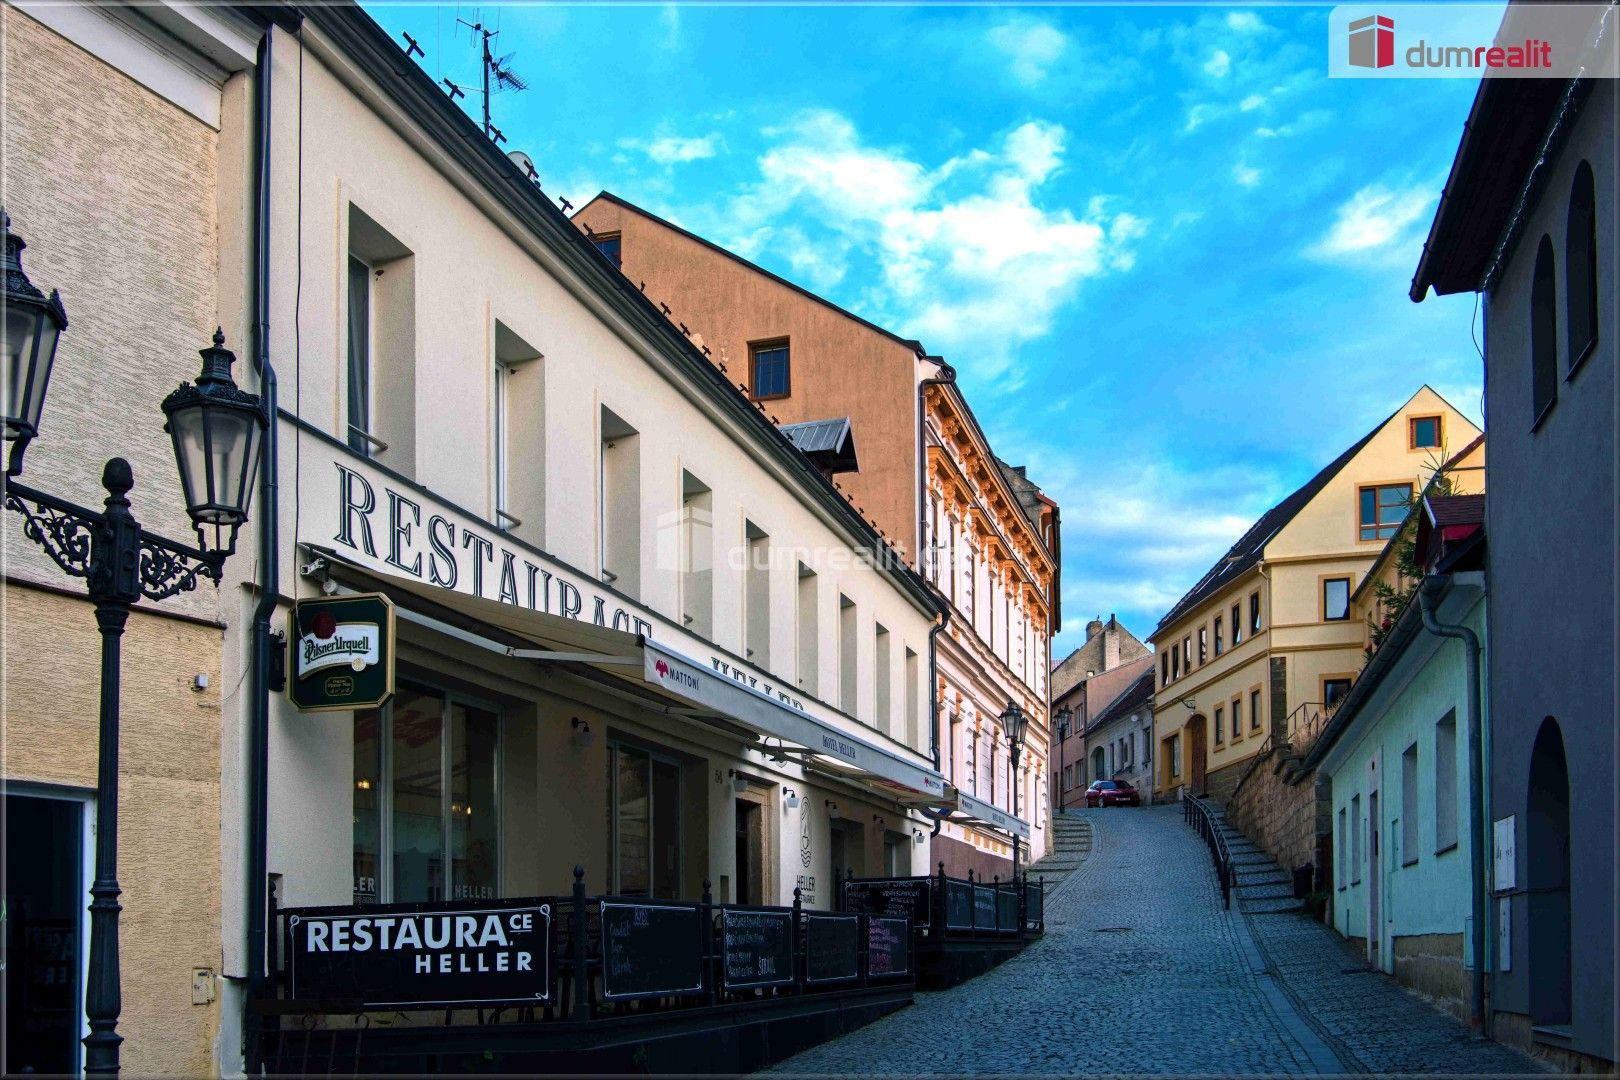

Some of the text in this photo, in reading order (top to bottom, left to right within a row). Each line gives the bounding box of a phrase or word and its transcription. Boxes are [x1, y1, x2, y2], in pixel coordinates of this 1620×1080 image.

[304, 639, 337, 665] Pilsner
[335, 636, 369, 655] Urquell
[455, 884, 494, 900] HELLER
[796, 875, 816, 892] HELLER
[415, 951, 533, 974] HELLER
